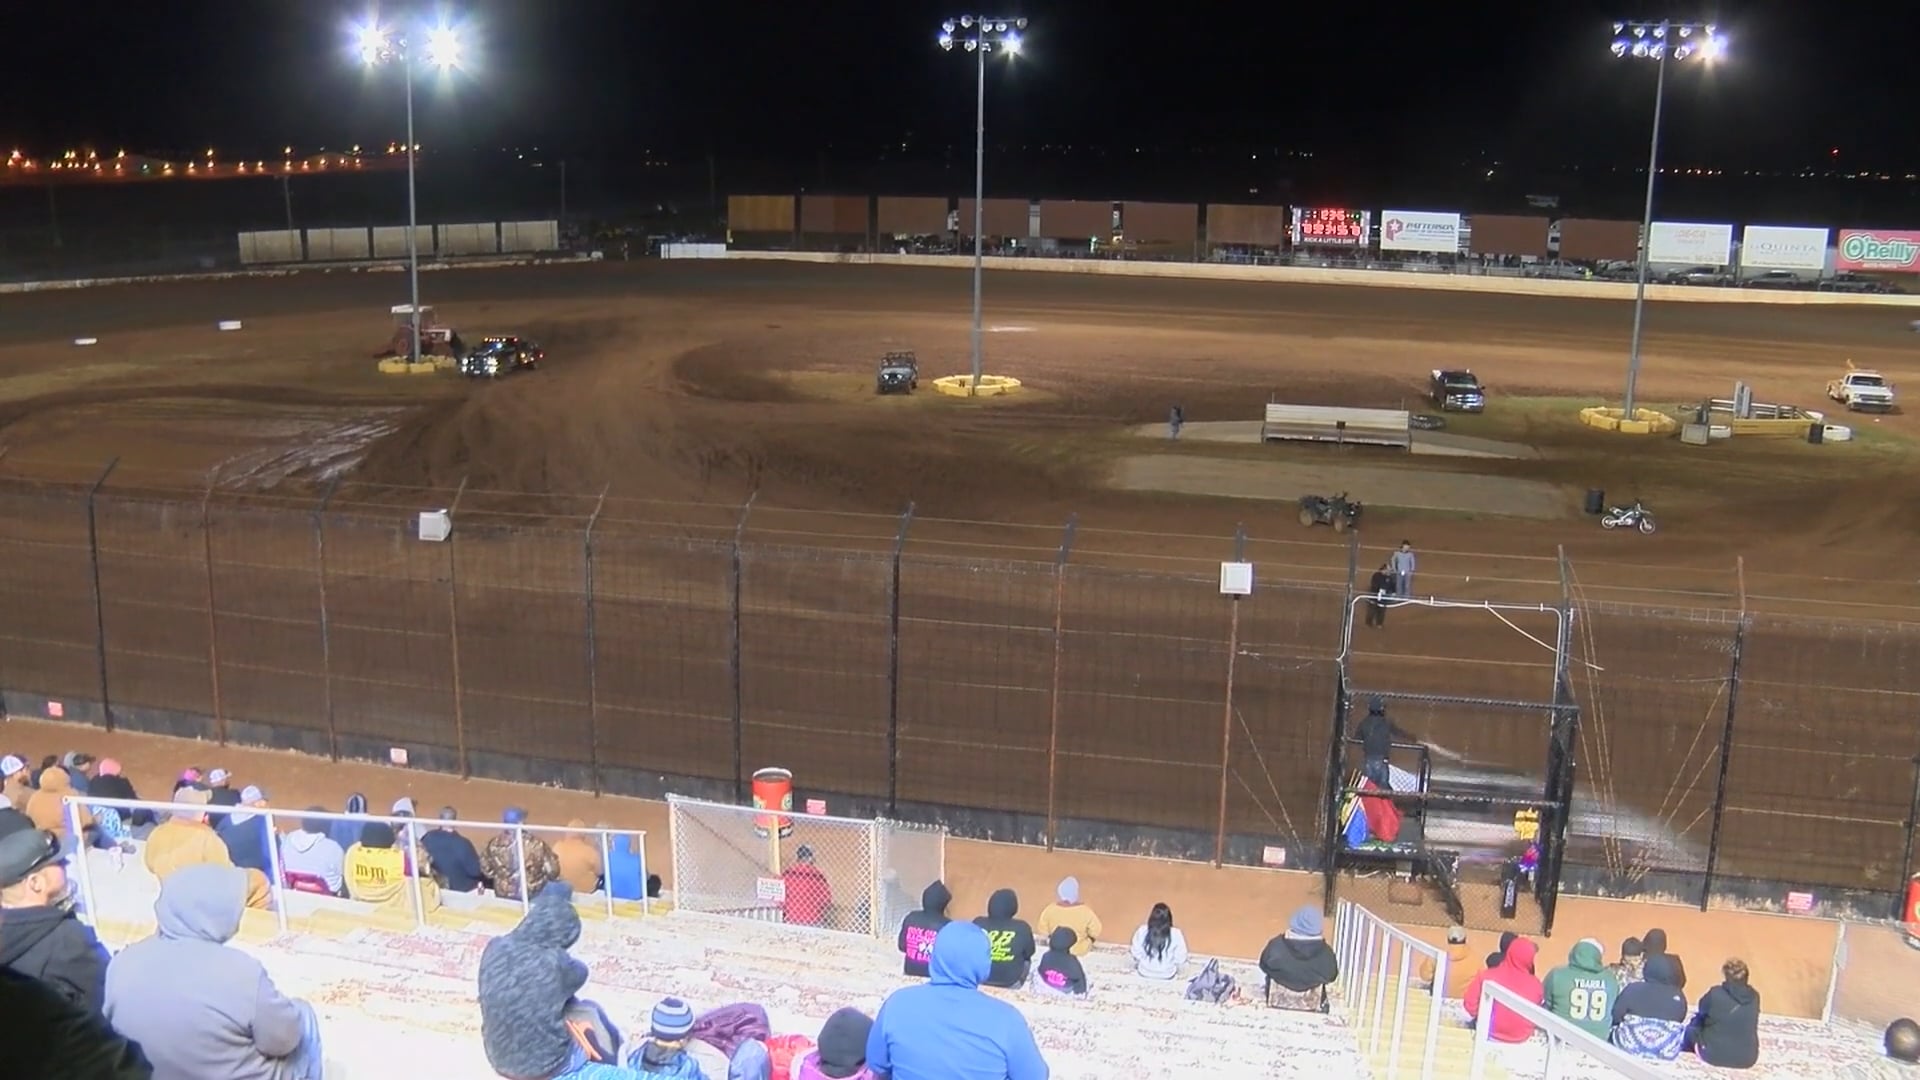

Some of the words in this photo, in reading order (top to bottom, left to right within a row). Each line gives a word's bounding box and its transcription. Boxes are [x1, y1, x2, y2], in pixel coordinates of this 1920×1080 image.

[1406, 222, 1455, 230] PATTERSON
[1761, 242, 1817, 252] QUINTA
[1843, 234, 1917, 263] O'Reilly
[1574, 978, 1606, 989] YBARRA
[1570, 988, 1608, 1021] 99
